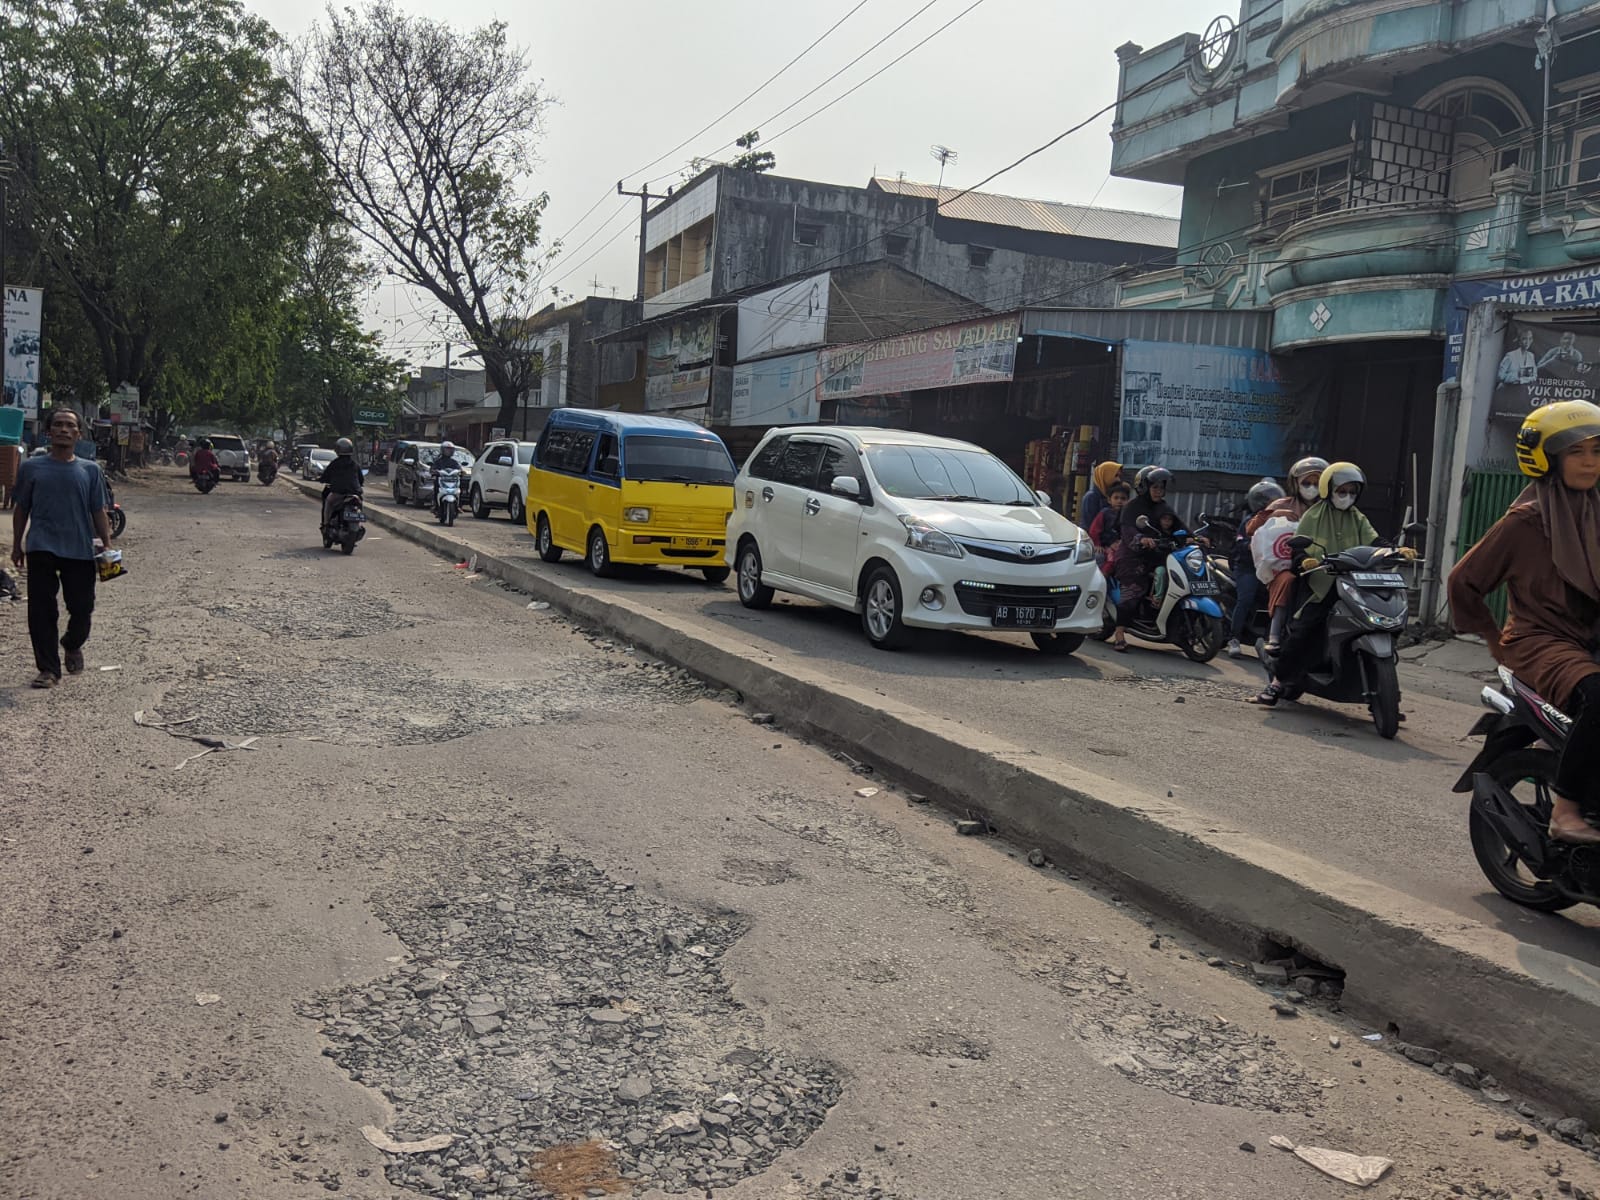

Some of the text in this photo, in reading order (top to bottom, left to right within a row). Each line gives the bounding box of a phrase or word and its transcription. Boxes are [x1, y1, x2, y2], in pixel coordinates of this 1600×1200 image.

[866, 334, 928, 363] BINTANG
[933, 319, 1017, 351] SAJADAH
[1527, 386, 1596, 399] YUK NGOPI
[997, 607, 1009, 618] AB
[1015, 607, 1036, 620] 1670
